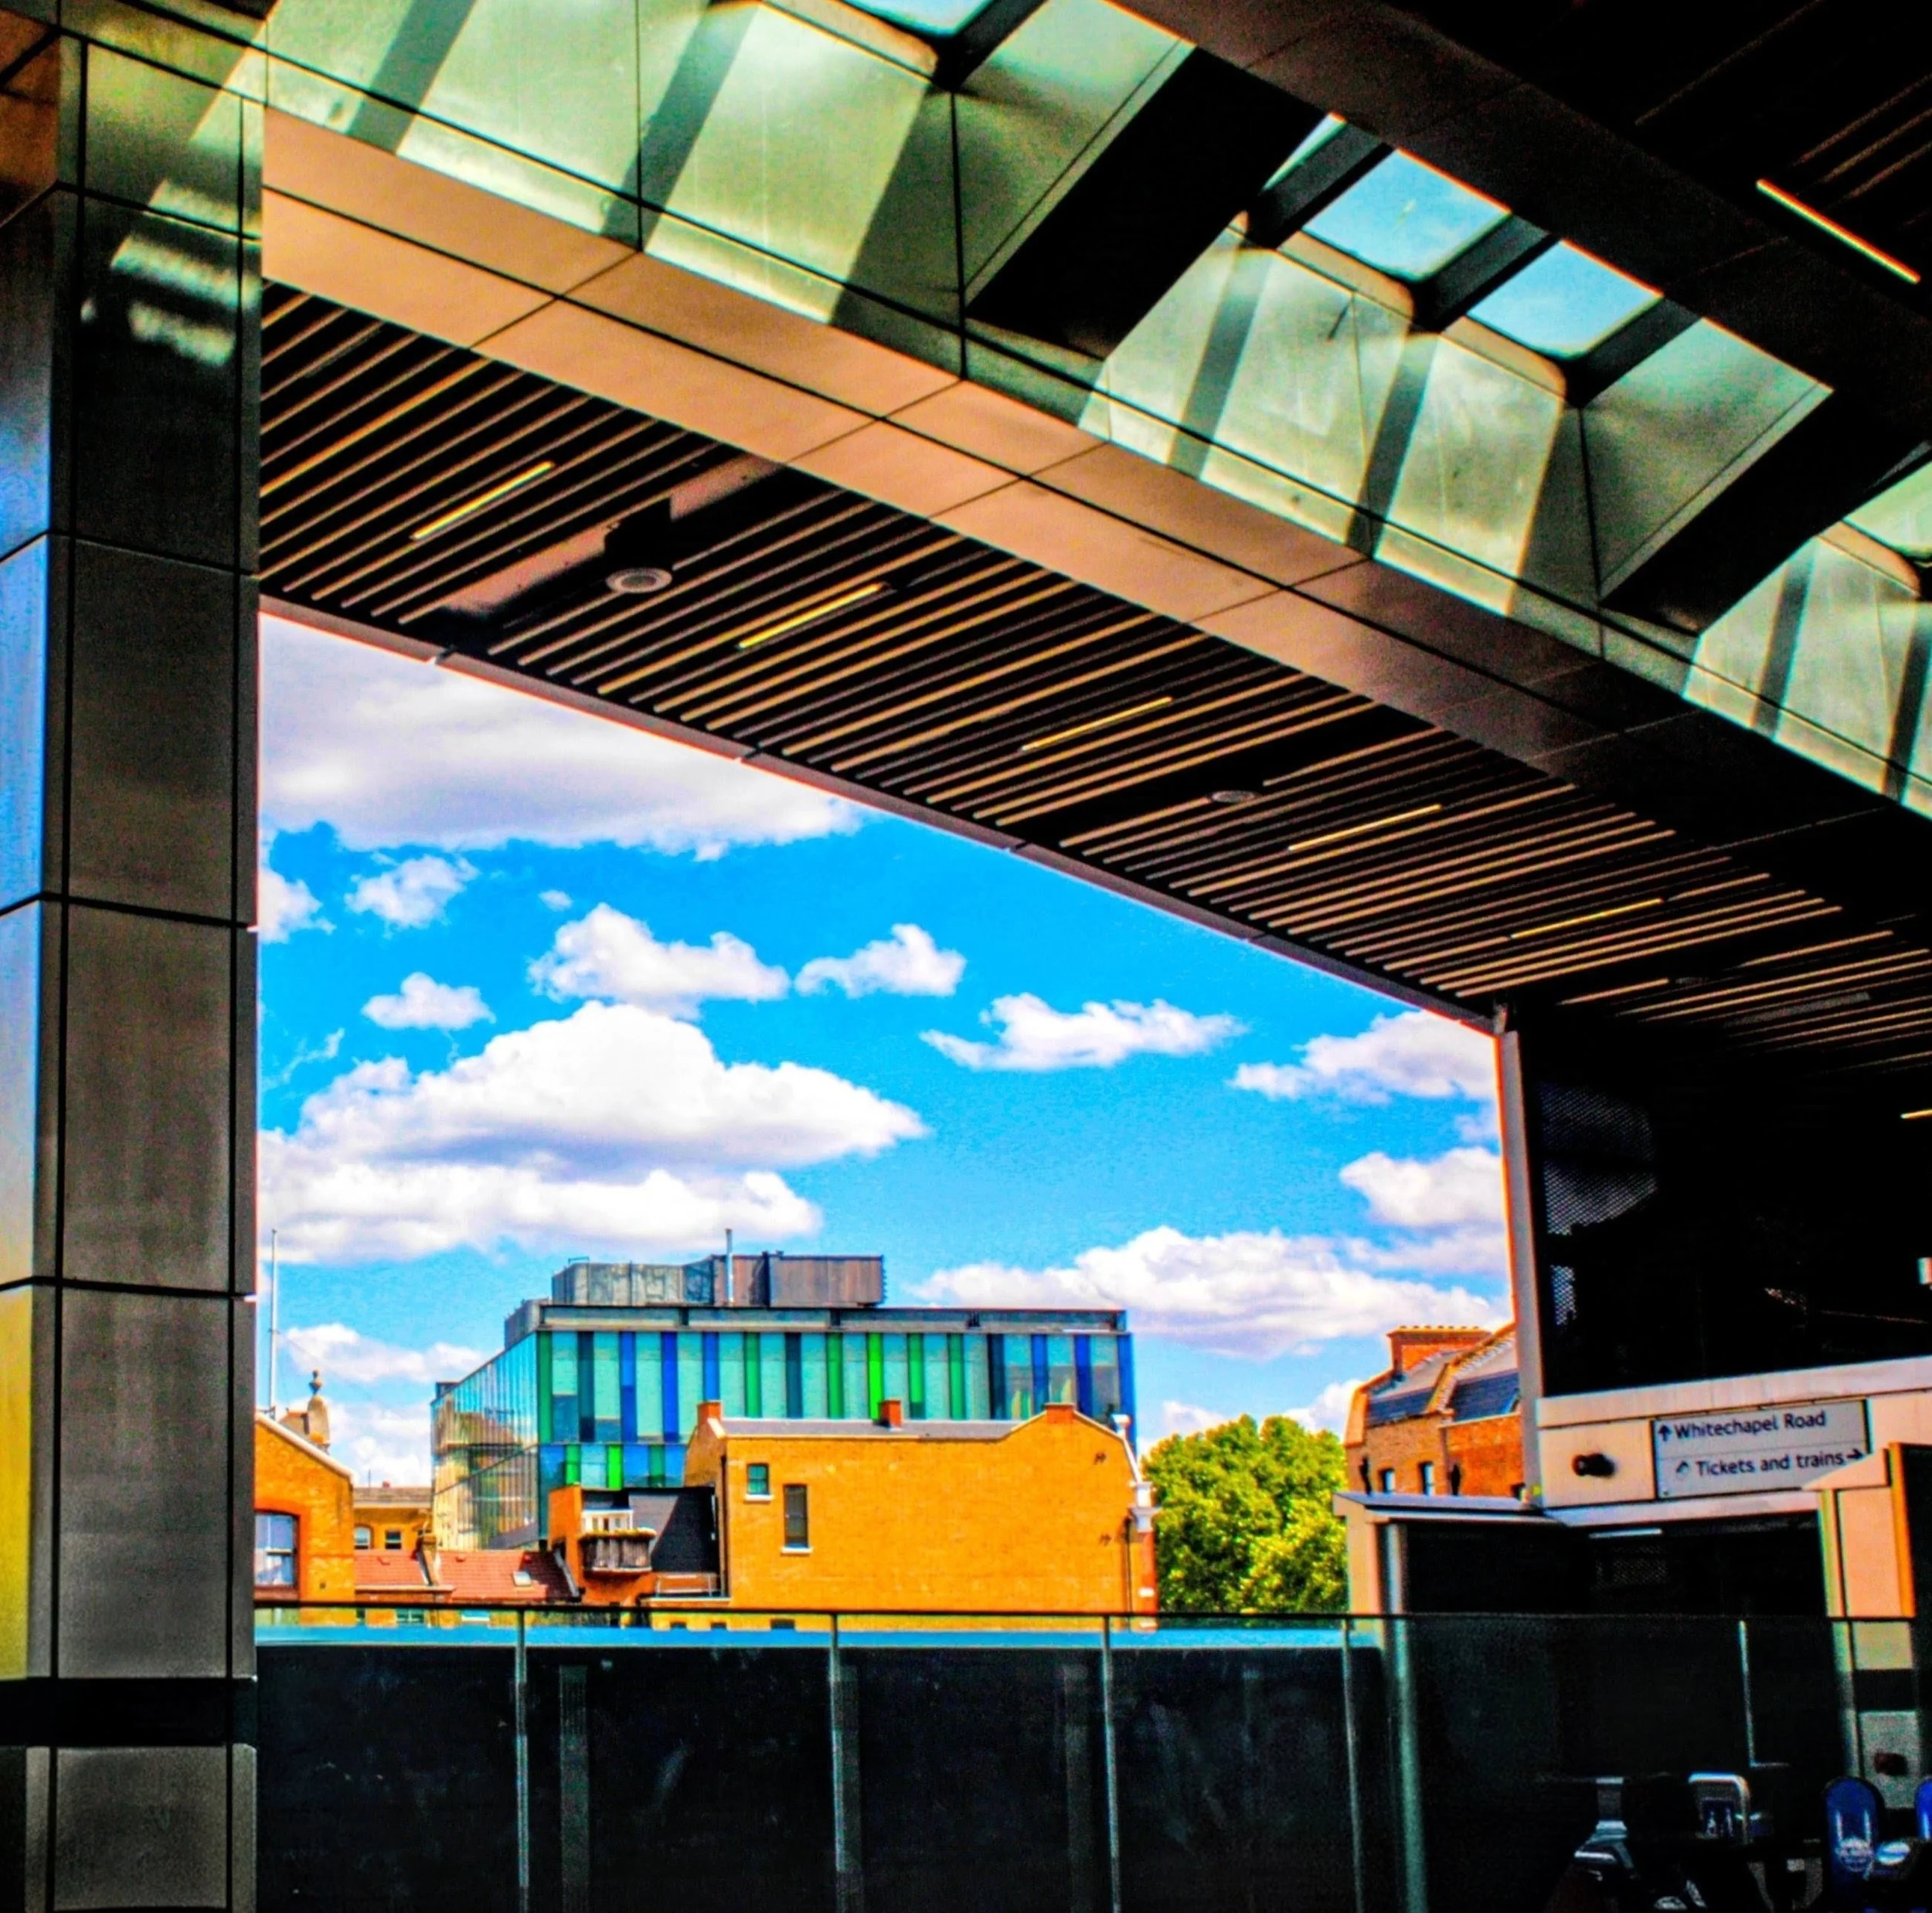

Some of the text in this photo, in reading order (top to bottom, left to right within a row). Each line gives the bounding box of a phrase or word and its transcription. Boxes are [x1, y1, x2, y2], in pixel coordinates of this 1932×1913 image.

[1674, 1411, 1826, 1439] Whitechapel Road
[1696, 1450, 1844, 1476] Tickets and trains
